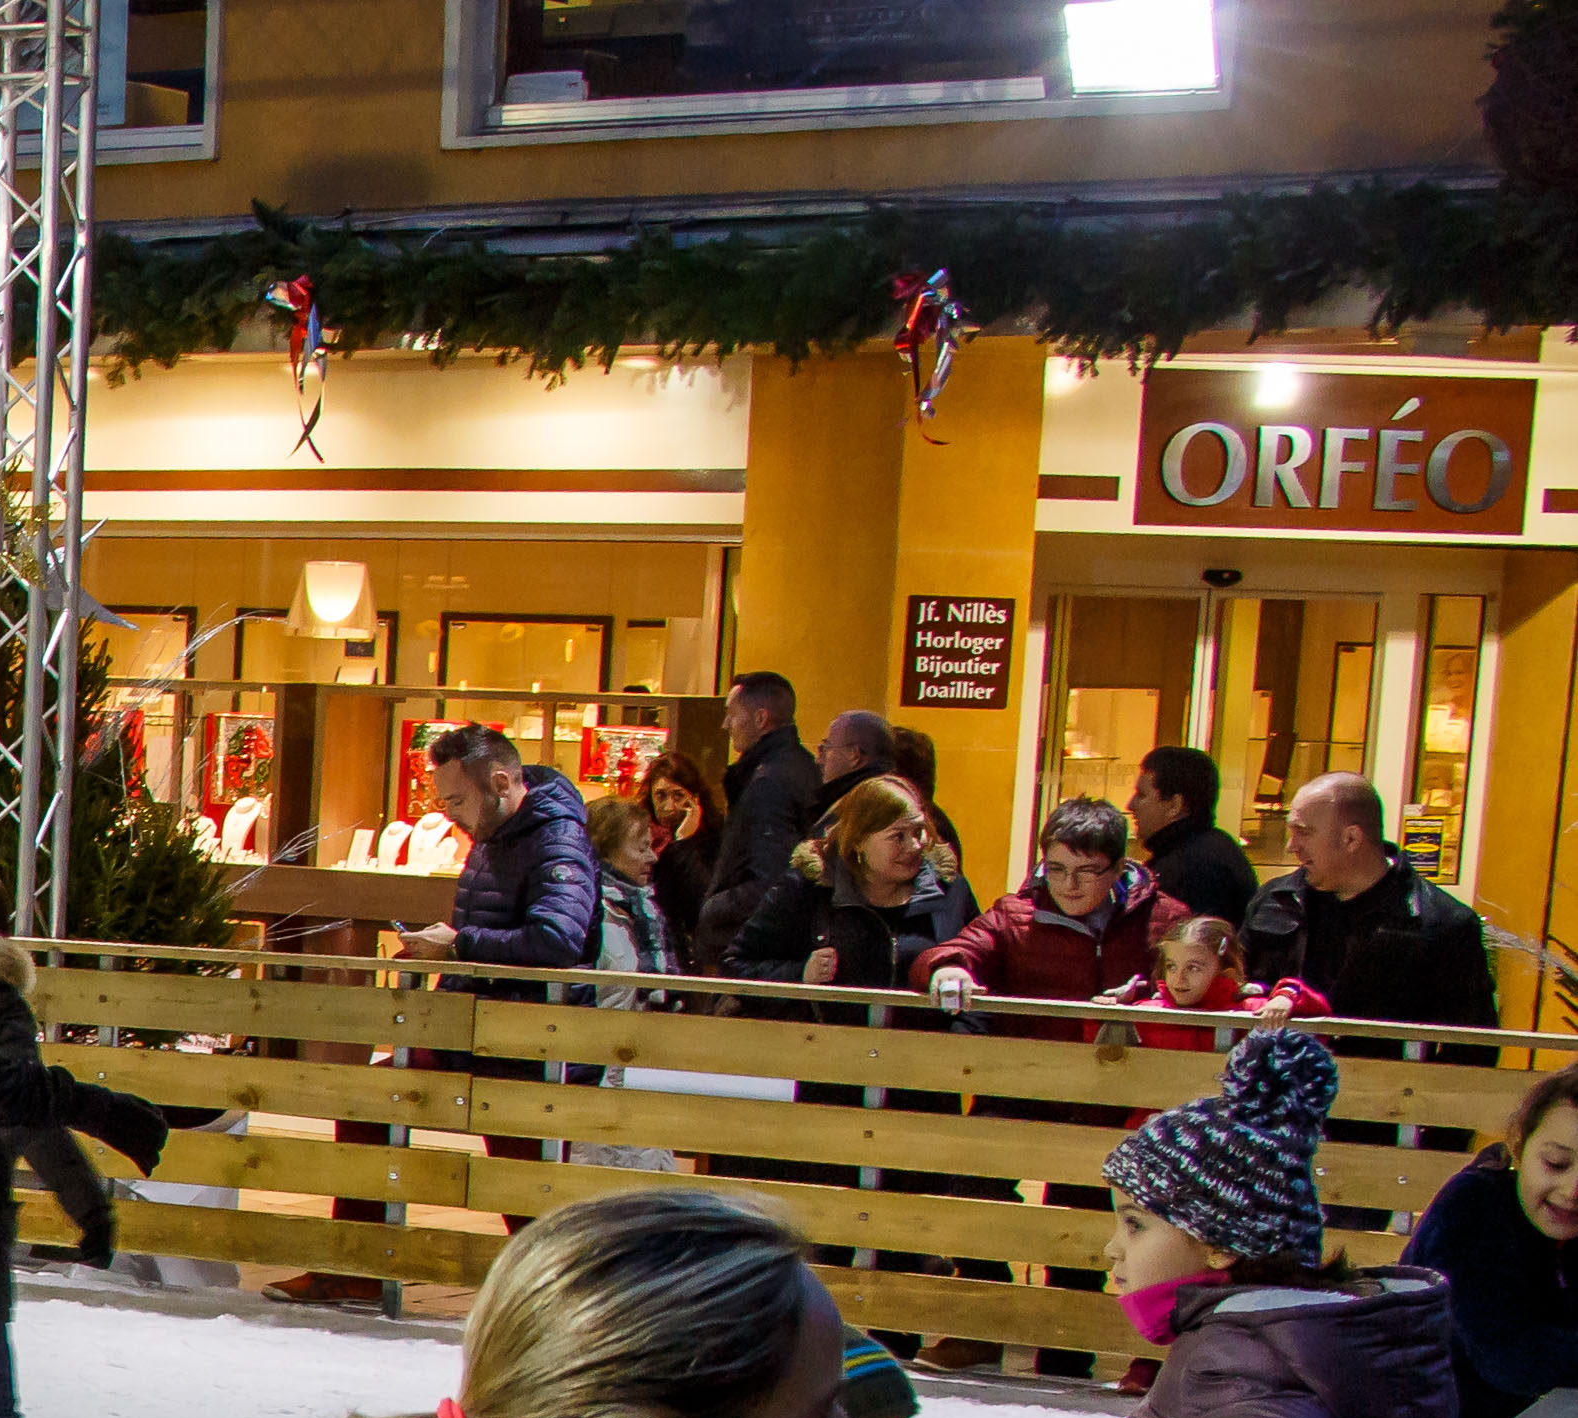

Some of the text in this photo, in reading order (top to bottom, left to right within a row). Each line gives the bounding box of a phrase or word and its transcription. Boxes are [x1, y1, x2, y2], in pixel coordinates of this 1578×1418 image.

[1162, 397, 1513, 513] ORFÉO
[918, 601, 1007, 624] Jf. Nillès
[916, 631, 1003, 654] Horloger
[916, 656, 1001, 677] Bijoutier
[918, 681, 995, 700] Joaillier
